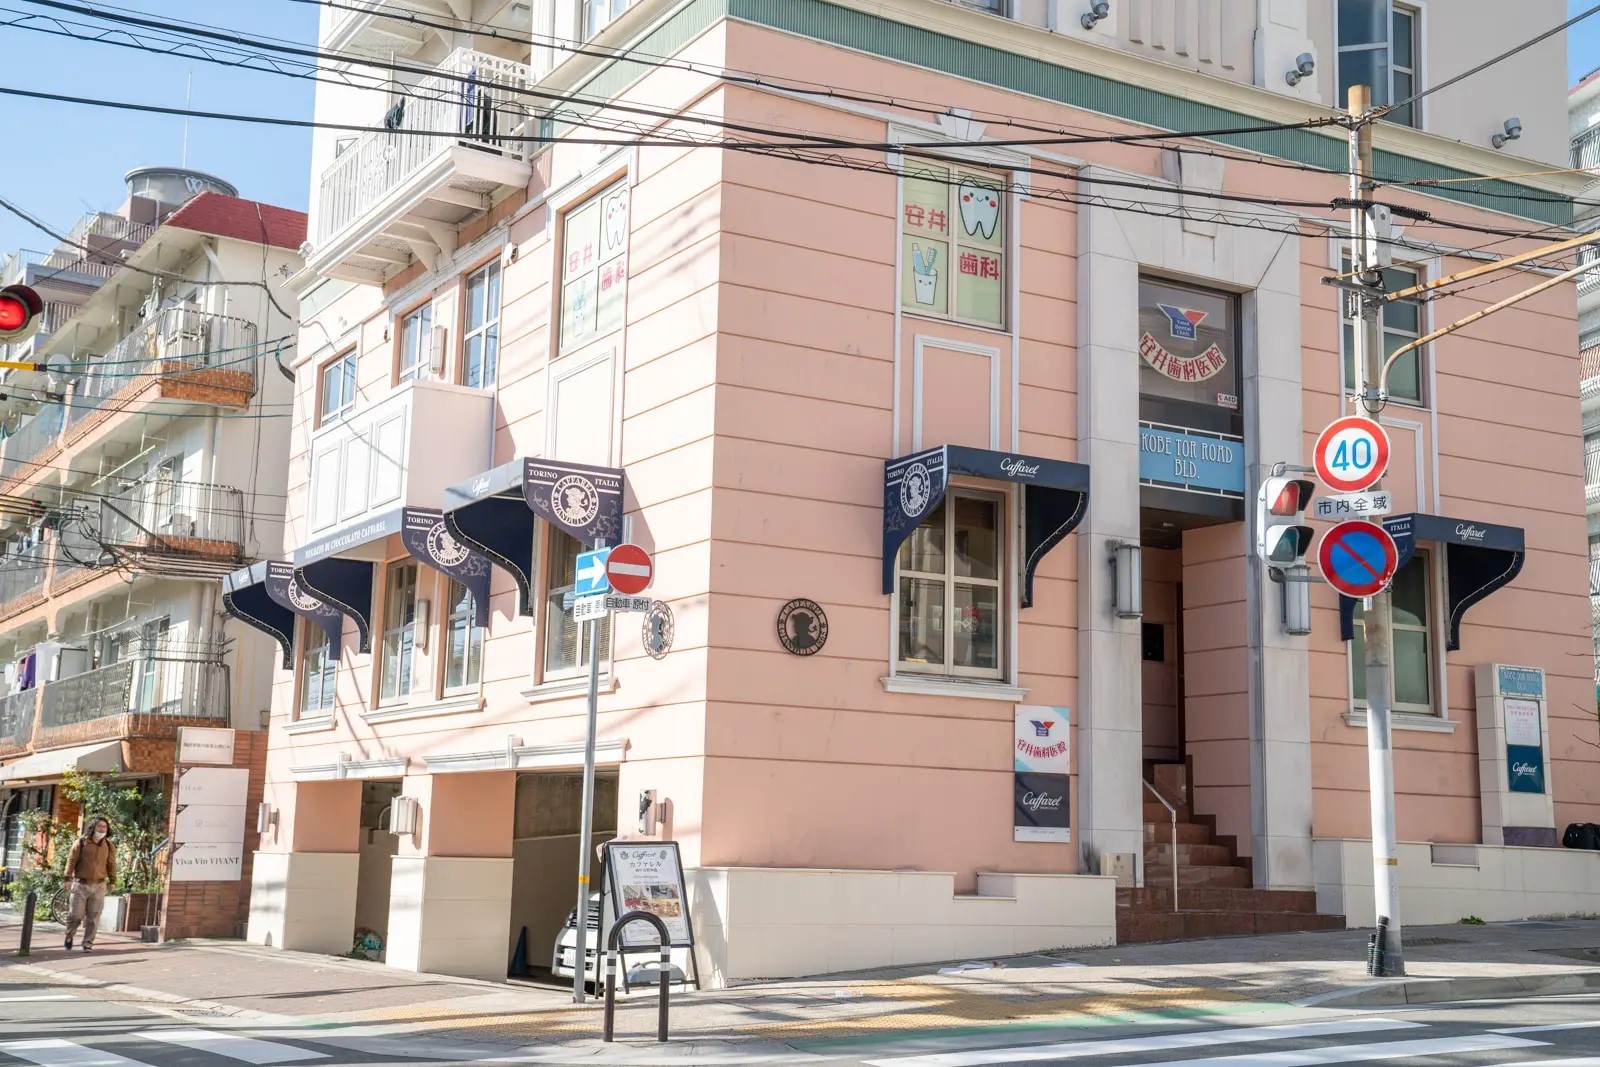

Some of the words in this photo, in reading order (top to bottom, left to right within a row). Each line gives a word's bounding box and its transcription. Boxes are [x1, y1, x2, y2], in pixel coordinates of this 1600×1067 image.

[905, 204, 946, 232] 安井
[959, 252, 999, 280] 歯科
[1140, 334, 1225, 380] 安井歯科医院
[1141, 433, 1171, 455] KOBE
[1176, 438, 1197, 458] TOR
[1201, 443, 1233, 464] ROAD
[1332, 437, 1372, 471] 40
[887, 468, 905, 479] TORINO
[927, 456, 943, 465] ITALIA
[1000, 458, 1040, 477] Caffarel
[1174, 459, 1200, 479] BLD.
[528, 469, 558, 480] TORINO
[595, 478, 620, 488] ITALIA
[1318, 495, 1388, 515] 市内全域
[406, 516, 434, 525] TORINO
[1391, 523, 1410, 531] ITALIA
[1455, 524, 1486, 540] Caffarel
[1017, 739, 1067, 758] 安井歯科医院
[1512, 762, 1538, 776] Caffarel
[1023, 792, 1062, 811] Caffarel
[195, 857, 208, 865] Vin
[210, 857, 239, 865] VIVANT
